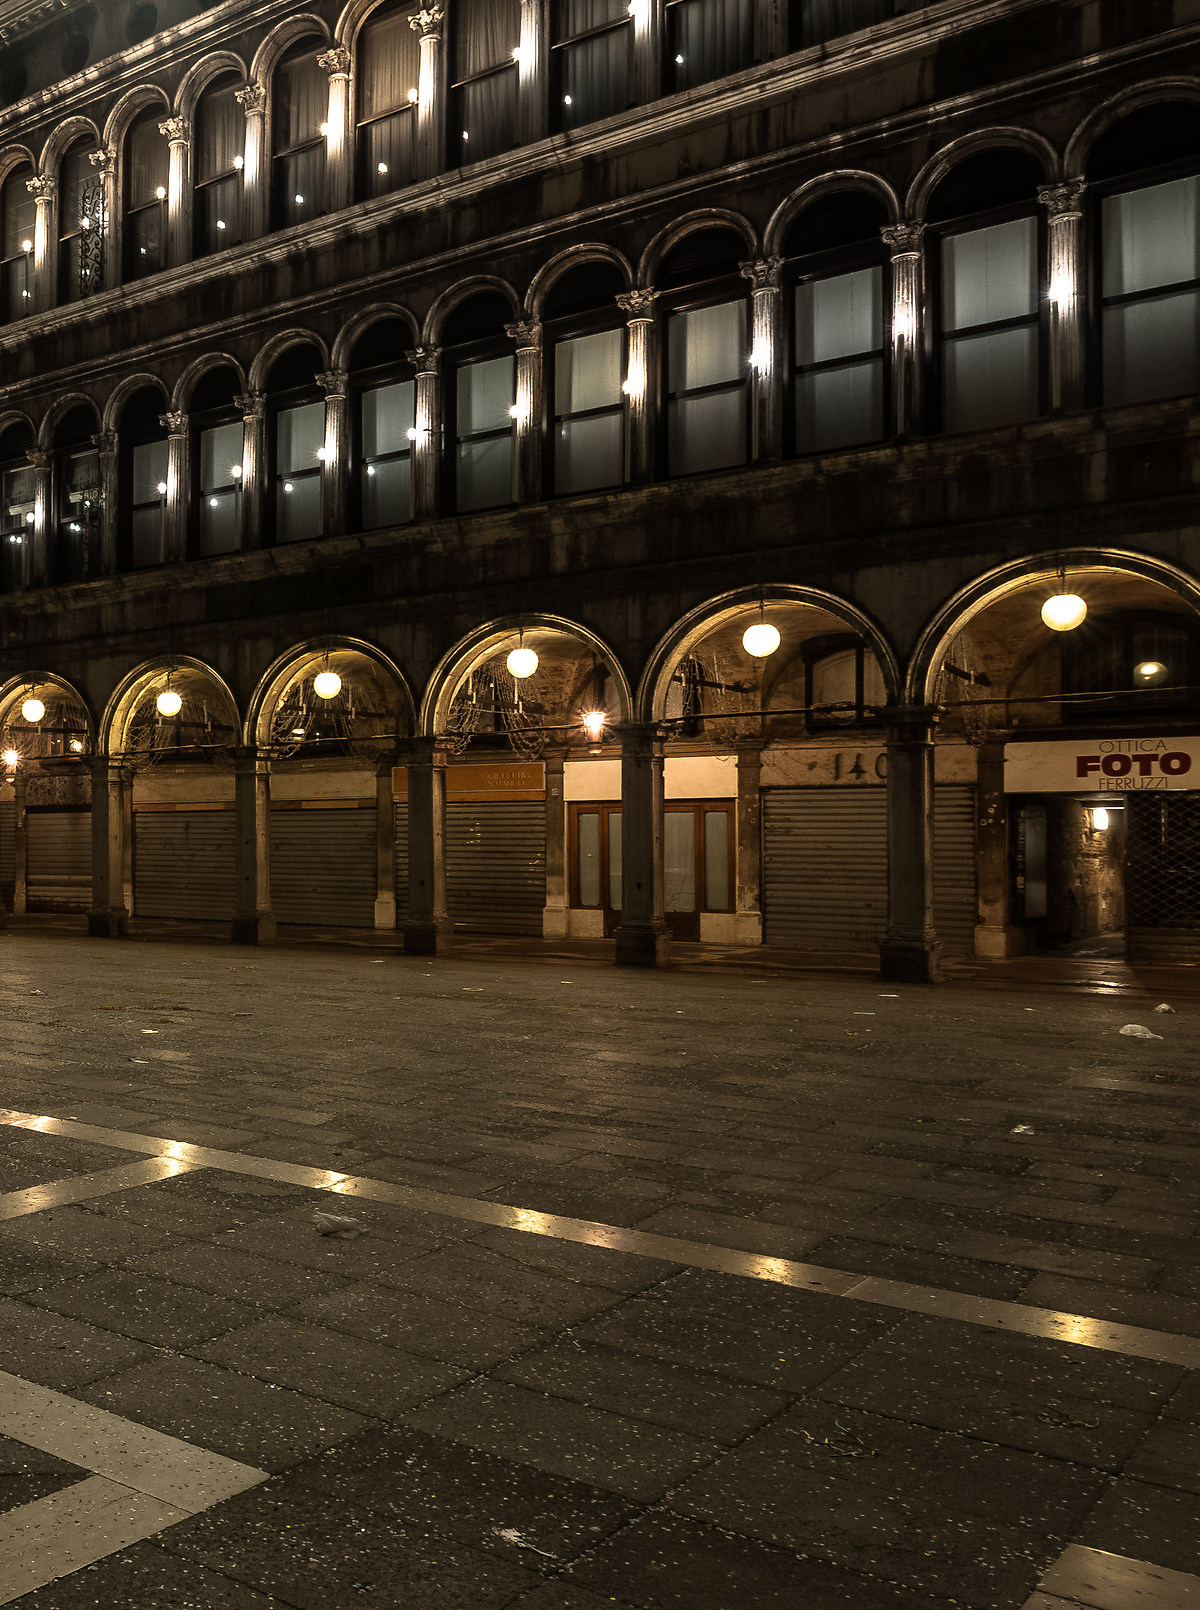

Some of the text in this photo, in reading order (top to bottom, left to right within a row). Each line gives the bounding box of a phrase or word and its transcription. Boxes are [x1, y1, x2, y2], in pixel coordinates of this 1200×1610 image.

[1099, 740, 1167, 753] OTTICA
[1076, 752, 1191, 777] FOTO
[1099, 777, 1167, 790] FERRUZZI
